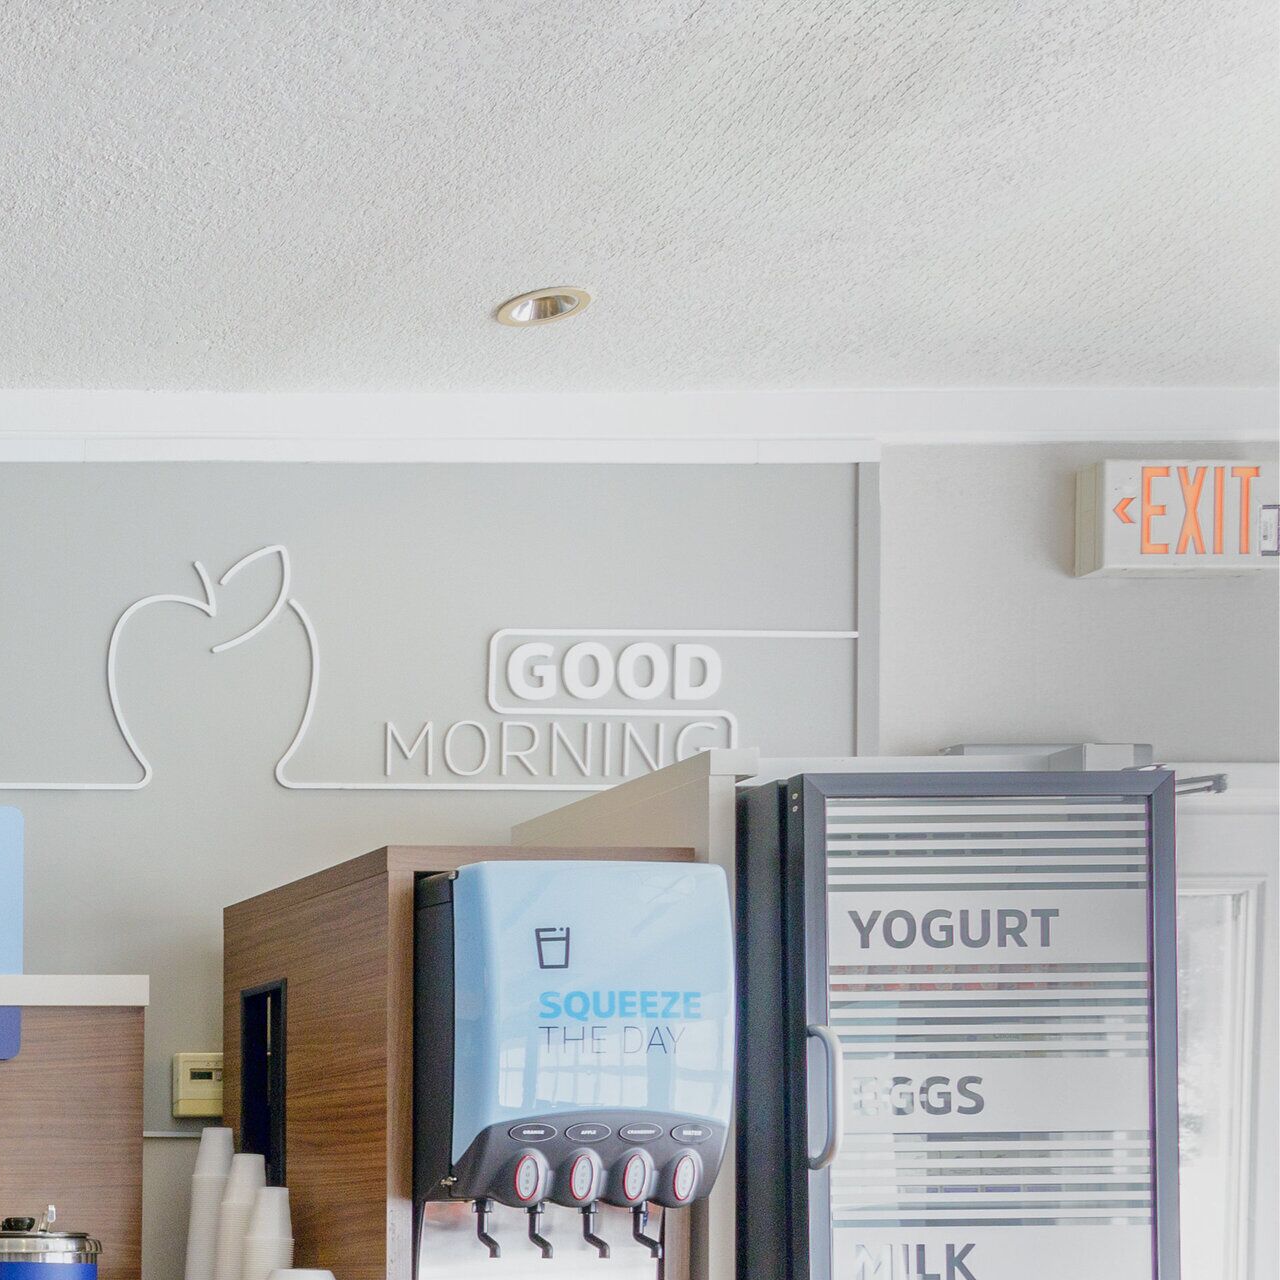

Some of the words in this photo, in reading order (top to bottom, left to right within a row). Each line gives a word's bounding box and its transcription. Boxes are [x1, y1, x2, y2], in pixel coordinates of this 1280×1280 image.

[1140, 466, 1260, 554] EXIT
[507, 641, 722, 700] GOOD
[384, 721, 719, 776] MORNING
[848, 908, 1059, 949] YOGURT
[539, 991, 701, 1022] SQUEEZE
[538, 1026, 607, 1054] THE
[623, 1026, 686, 1054] DAY
